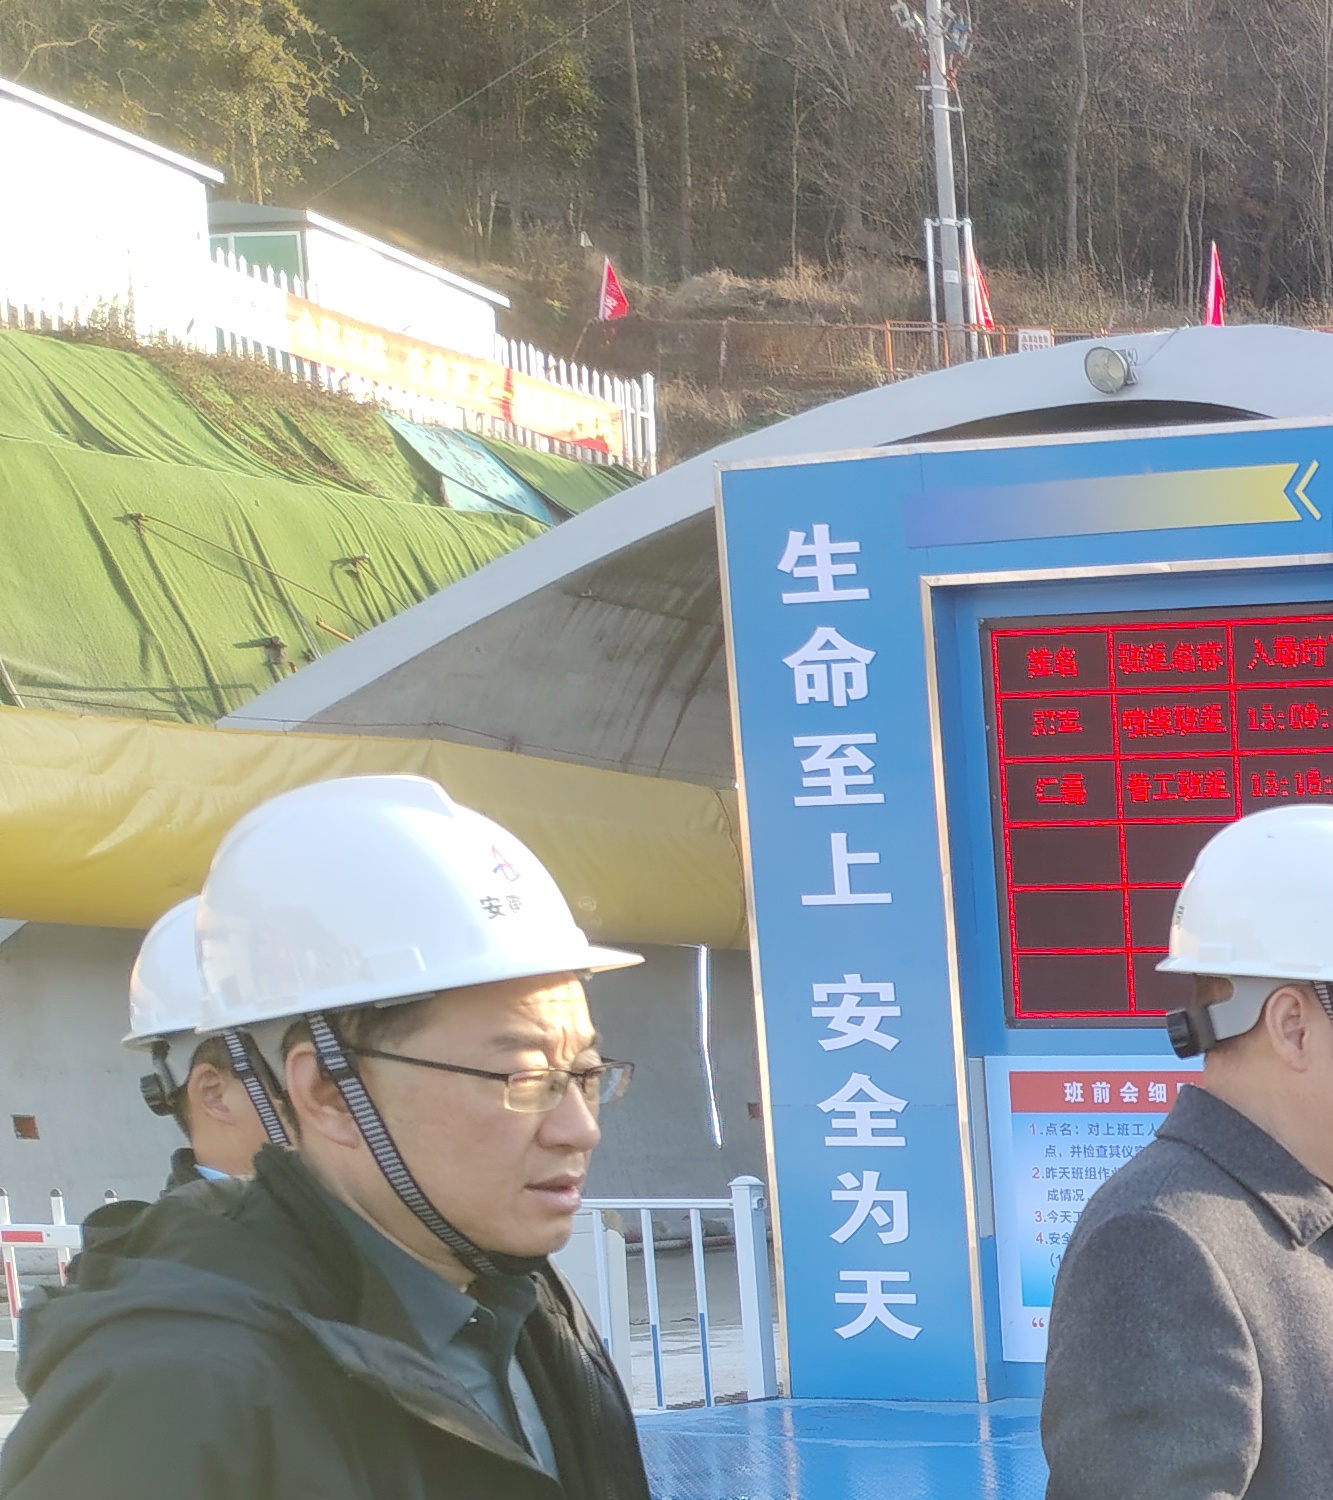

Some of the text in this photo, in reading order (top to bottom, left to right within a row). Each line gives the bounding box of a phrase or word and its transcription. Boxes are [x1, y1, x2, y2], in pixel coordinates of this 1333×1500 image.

[777, 522, 922, 1340] 生命至上 安全为天
